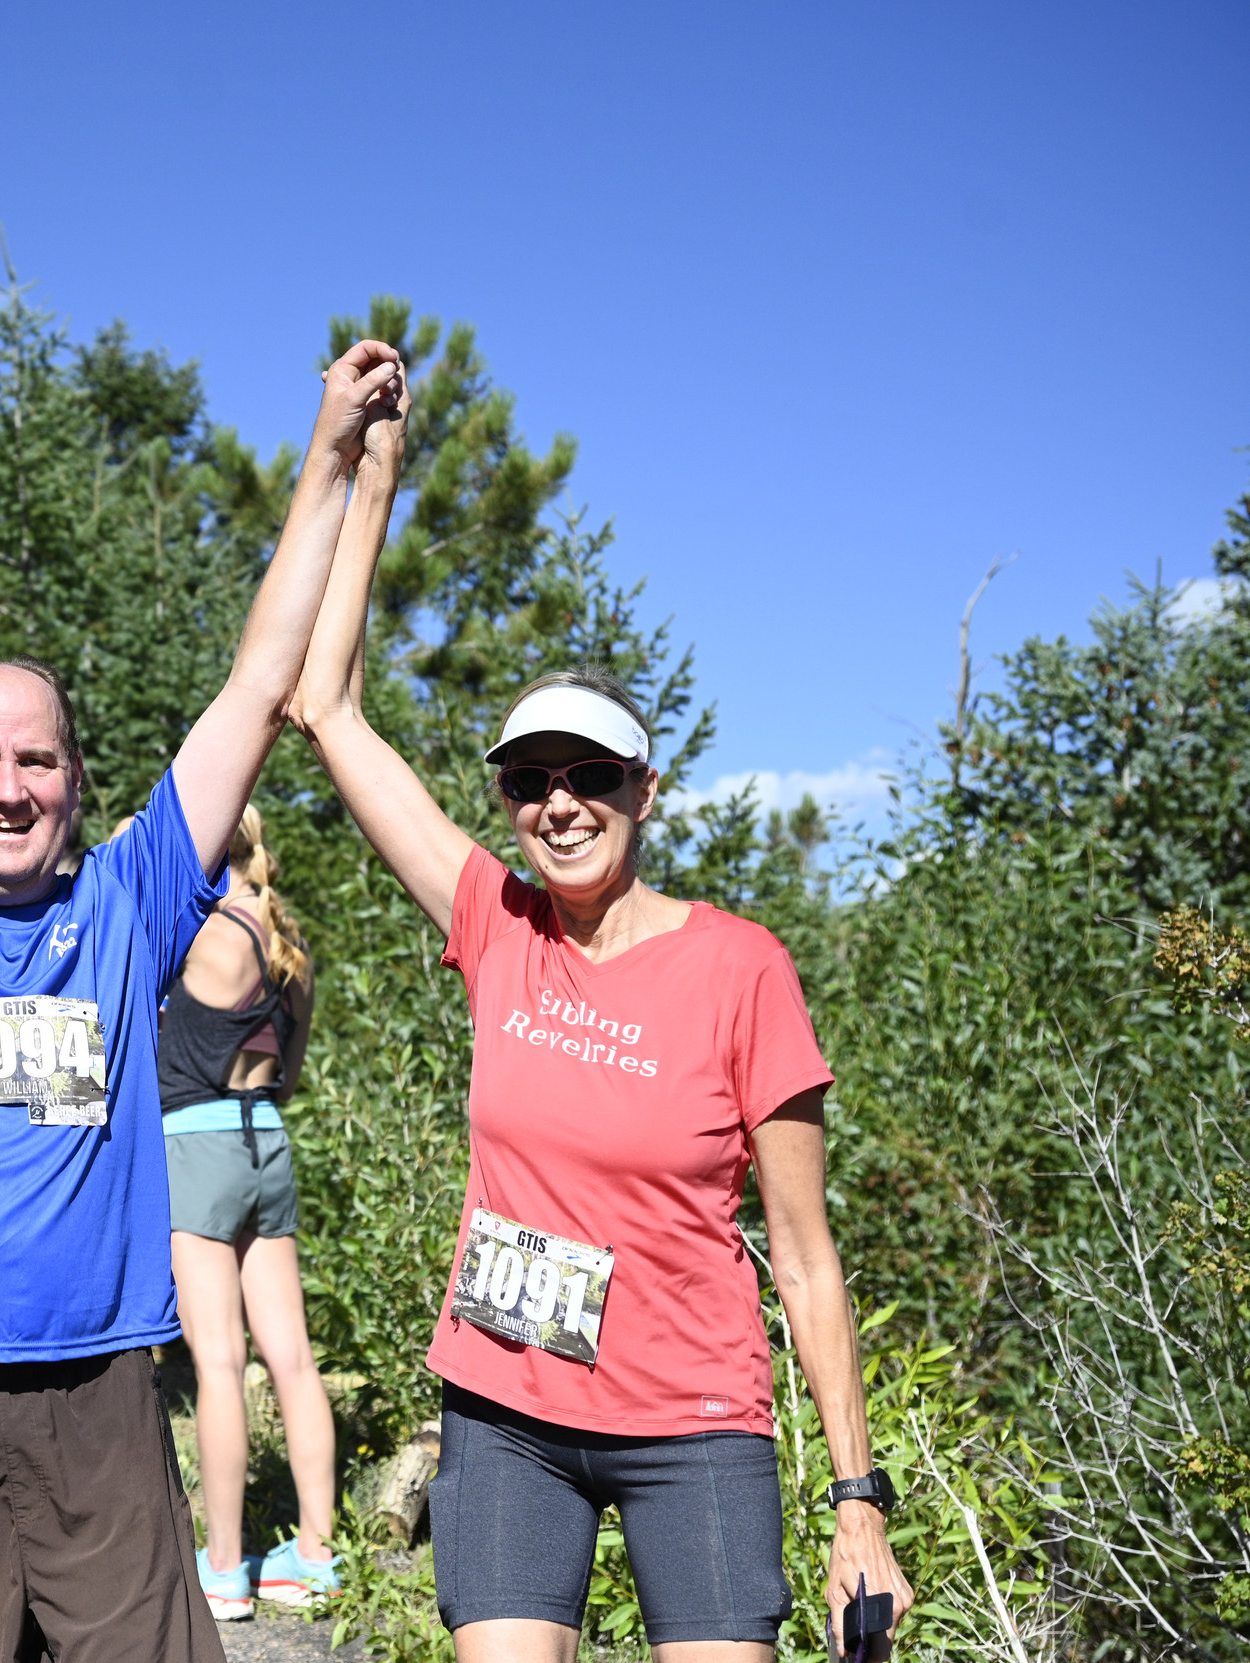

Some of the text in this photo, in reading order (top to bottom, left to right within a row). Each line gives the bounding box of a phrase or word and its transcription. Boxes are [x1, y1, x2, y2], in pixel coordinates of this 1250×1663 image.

[2, 1000, 37, 1016] GTIS
[539, 990, 642, 1045] Sibling
[500, 1009, 658, 1077] Revelries
[3, 1080, 48, 1095] WILLIAM
[79, 1105, 101, 1117] BEER
[517, 1230, 547, 1254] GTIS
[472, 1240, 589, 1334] 1091
[493, 1311, 538, 1338] JENNIFER
